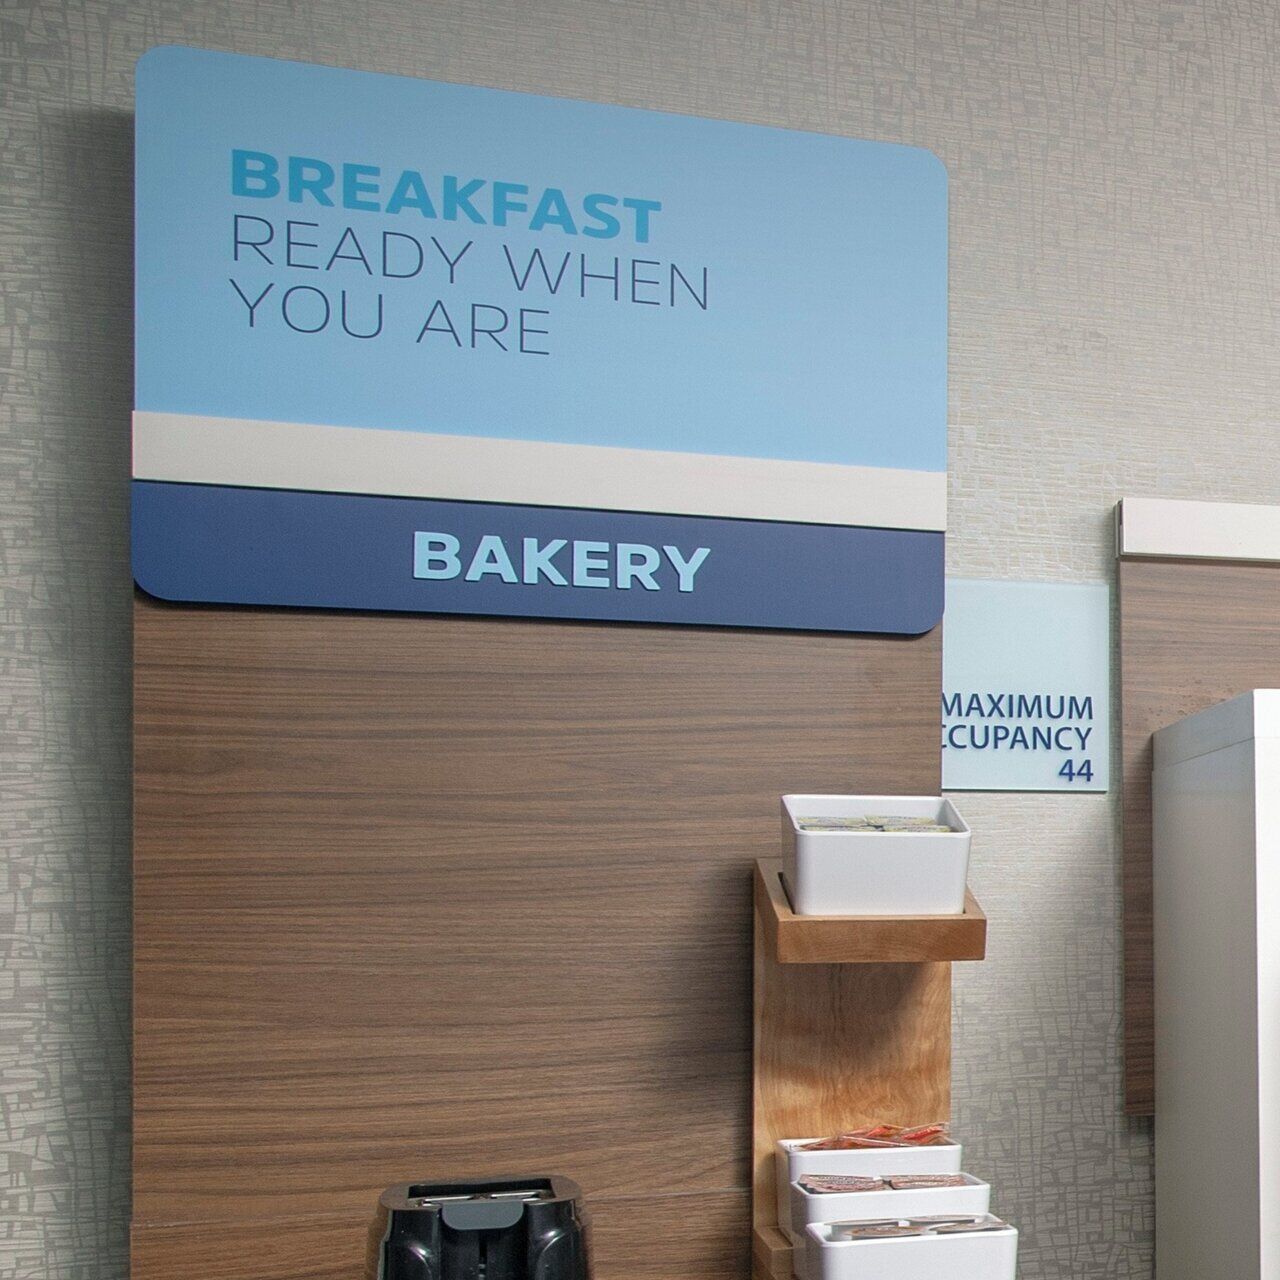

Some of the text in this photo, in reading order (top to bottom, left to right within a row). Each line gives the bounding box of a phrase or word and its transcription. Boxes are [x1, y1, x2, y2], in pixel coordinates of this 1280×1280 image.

[231, 148, 662, 243] BREAKFAST
[232, 214, 710, 312] READY WHEN
[229, 277, 551, 356] YOU ARE
[412, 530, 711, 593] BAKERY
[942, 692, 1094, 720] MAXIMUM
[1058, 759, 1094, 782] 44
